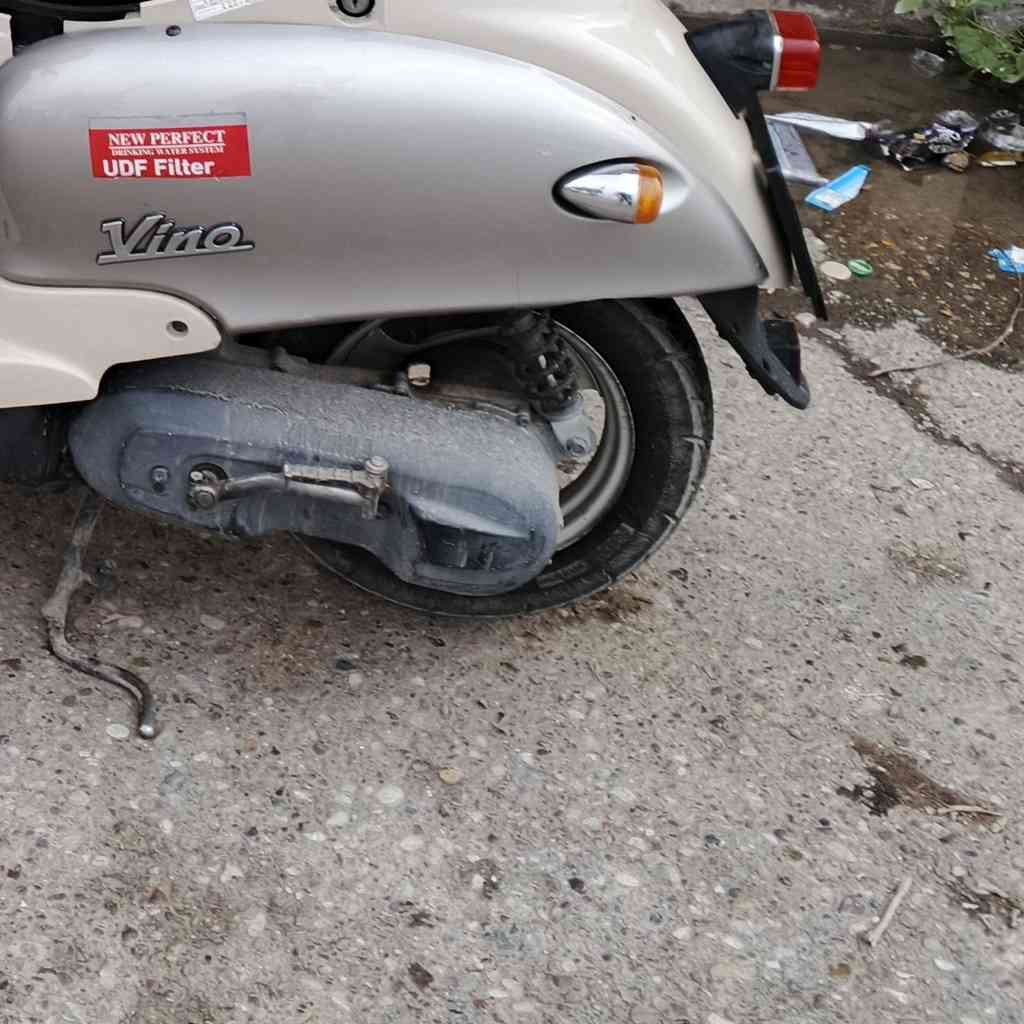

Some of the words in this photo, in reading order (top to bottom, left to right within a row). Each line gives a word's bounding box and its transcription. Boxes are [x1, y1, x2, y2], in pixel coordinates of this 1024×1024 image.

[108, 132, 146, 146] NEW
[150, 129, 226, 145] PERFECT
[111, 147, 154, 157] DRINKING
[155, 146, 188, 156] WATER
[188, 144, 225, 154] SYSTEM
[102, 159, 148, 177] UDF
[153, 157, 216, 176] Filter
[96, 213, 255, 265] Vino
